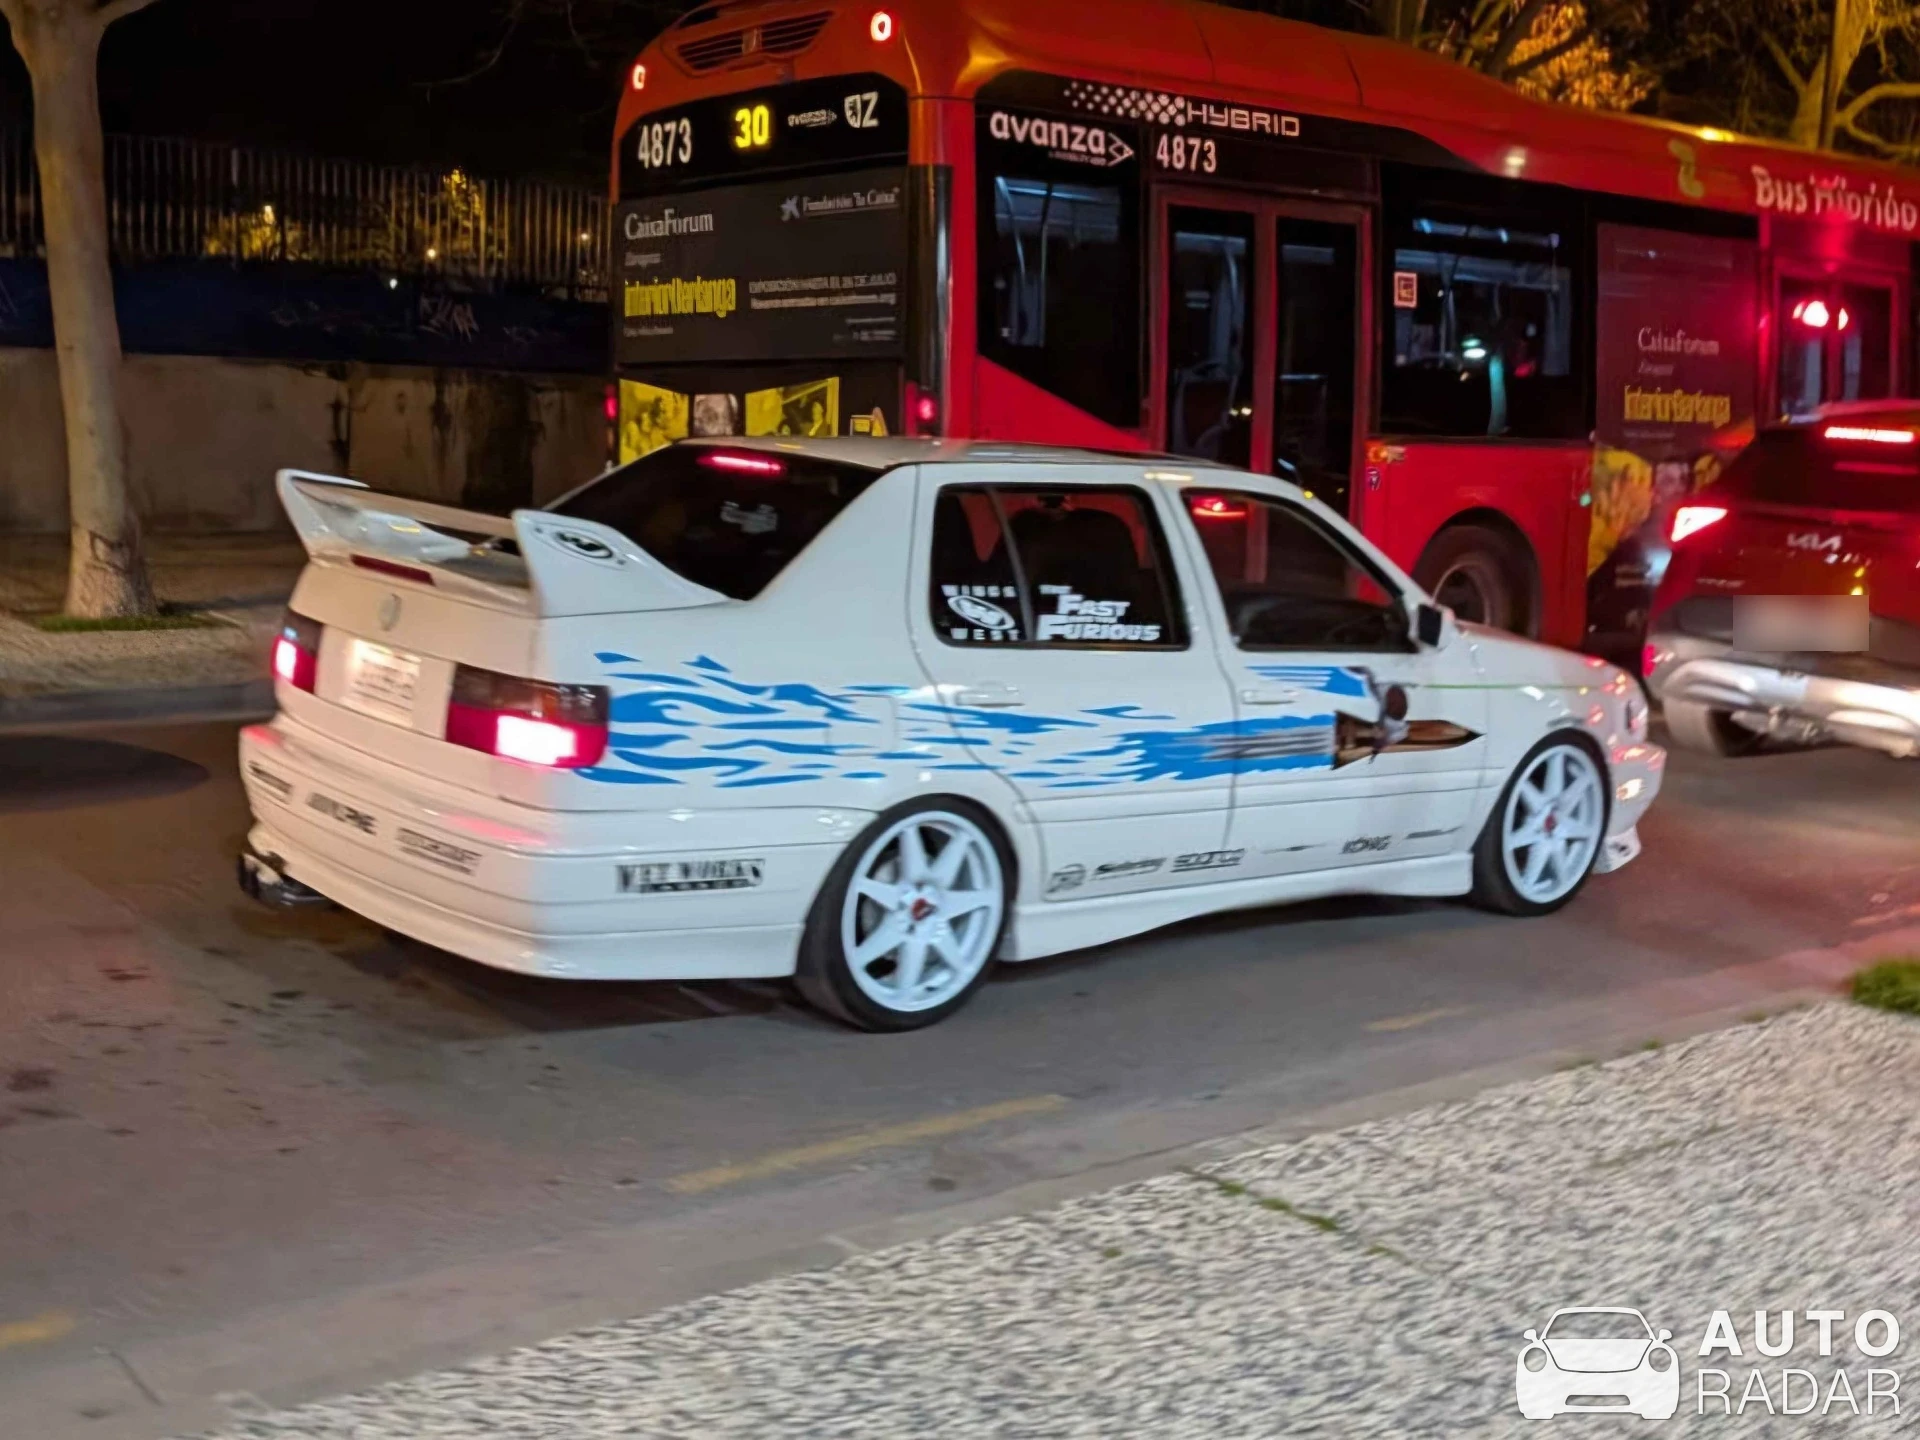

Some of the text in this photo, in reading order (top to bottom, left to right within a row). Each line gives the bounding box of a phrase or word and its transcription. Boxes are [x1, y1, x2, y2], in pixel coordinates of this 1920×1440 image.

[735, 104, 770, 148] 30
[989, 111, 1105, 155] avanza
[1186, 101, 1300, 137] HYBRID
[637, 117, 692, 169] 4873
[1156, 133, 1217, 173] 4873
[1751, 164, 1808, 214] Bus
